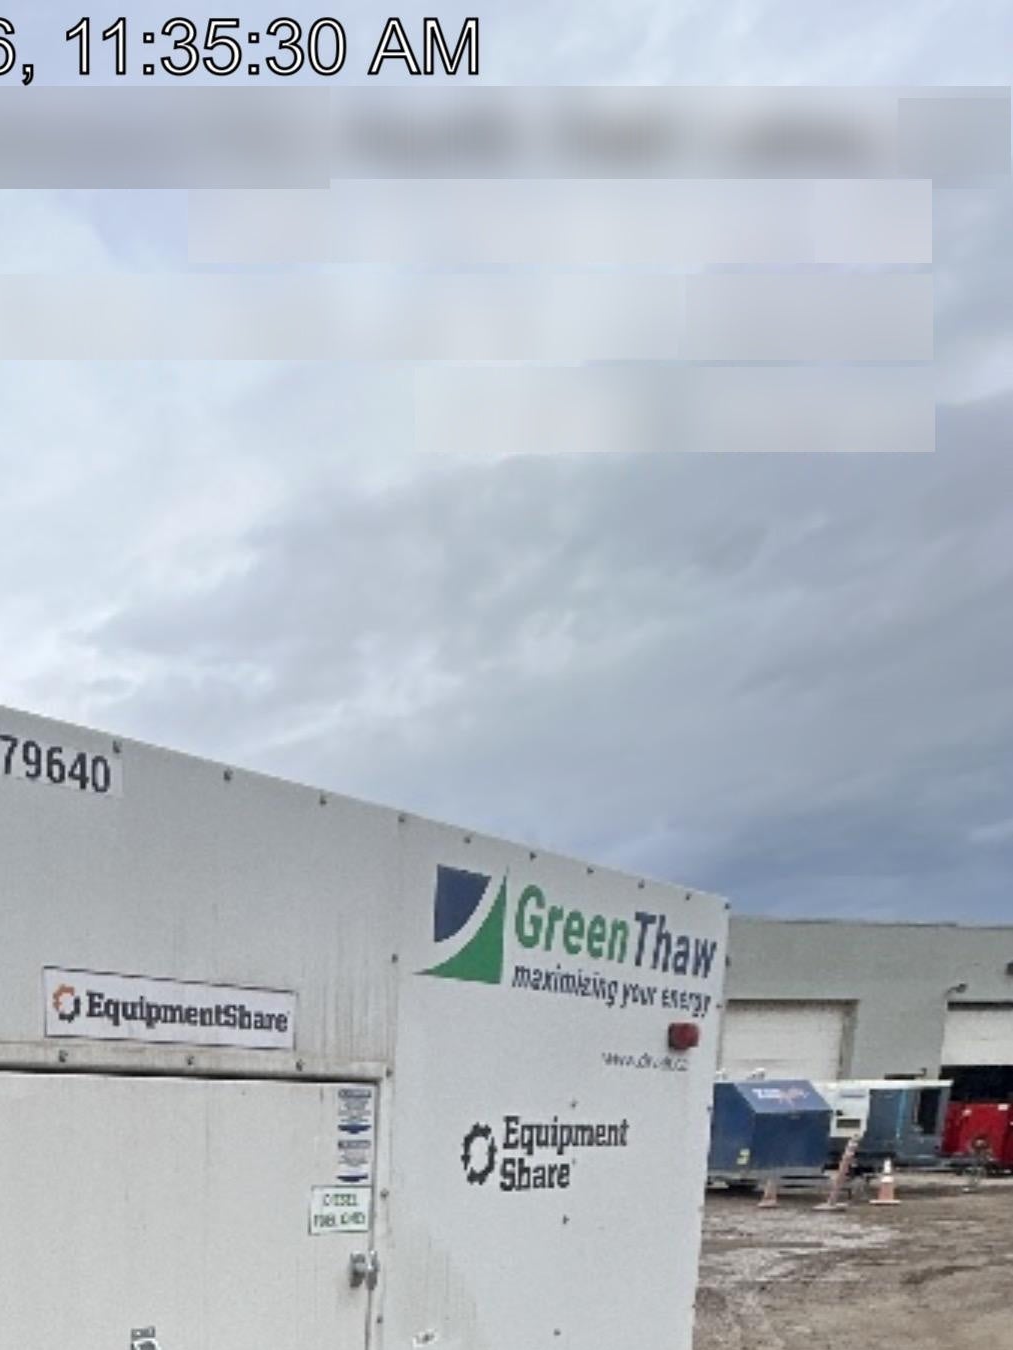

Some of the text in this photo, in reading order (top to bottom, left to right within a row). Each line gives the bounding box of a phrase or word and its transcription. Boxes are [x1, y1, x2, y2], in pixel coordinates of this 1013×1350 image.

[86, 989, 289, 1032] EquipmentShare
[512, 964, 712, 1018] maximizing your energy
[502, 1115, 630, 1156] Equipment
[499, 1157, 570, 1192] Share
